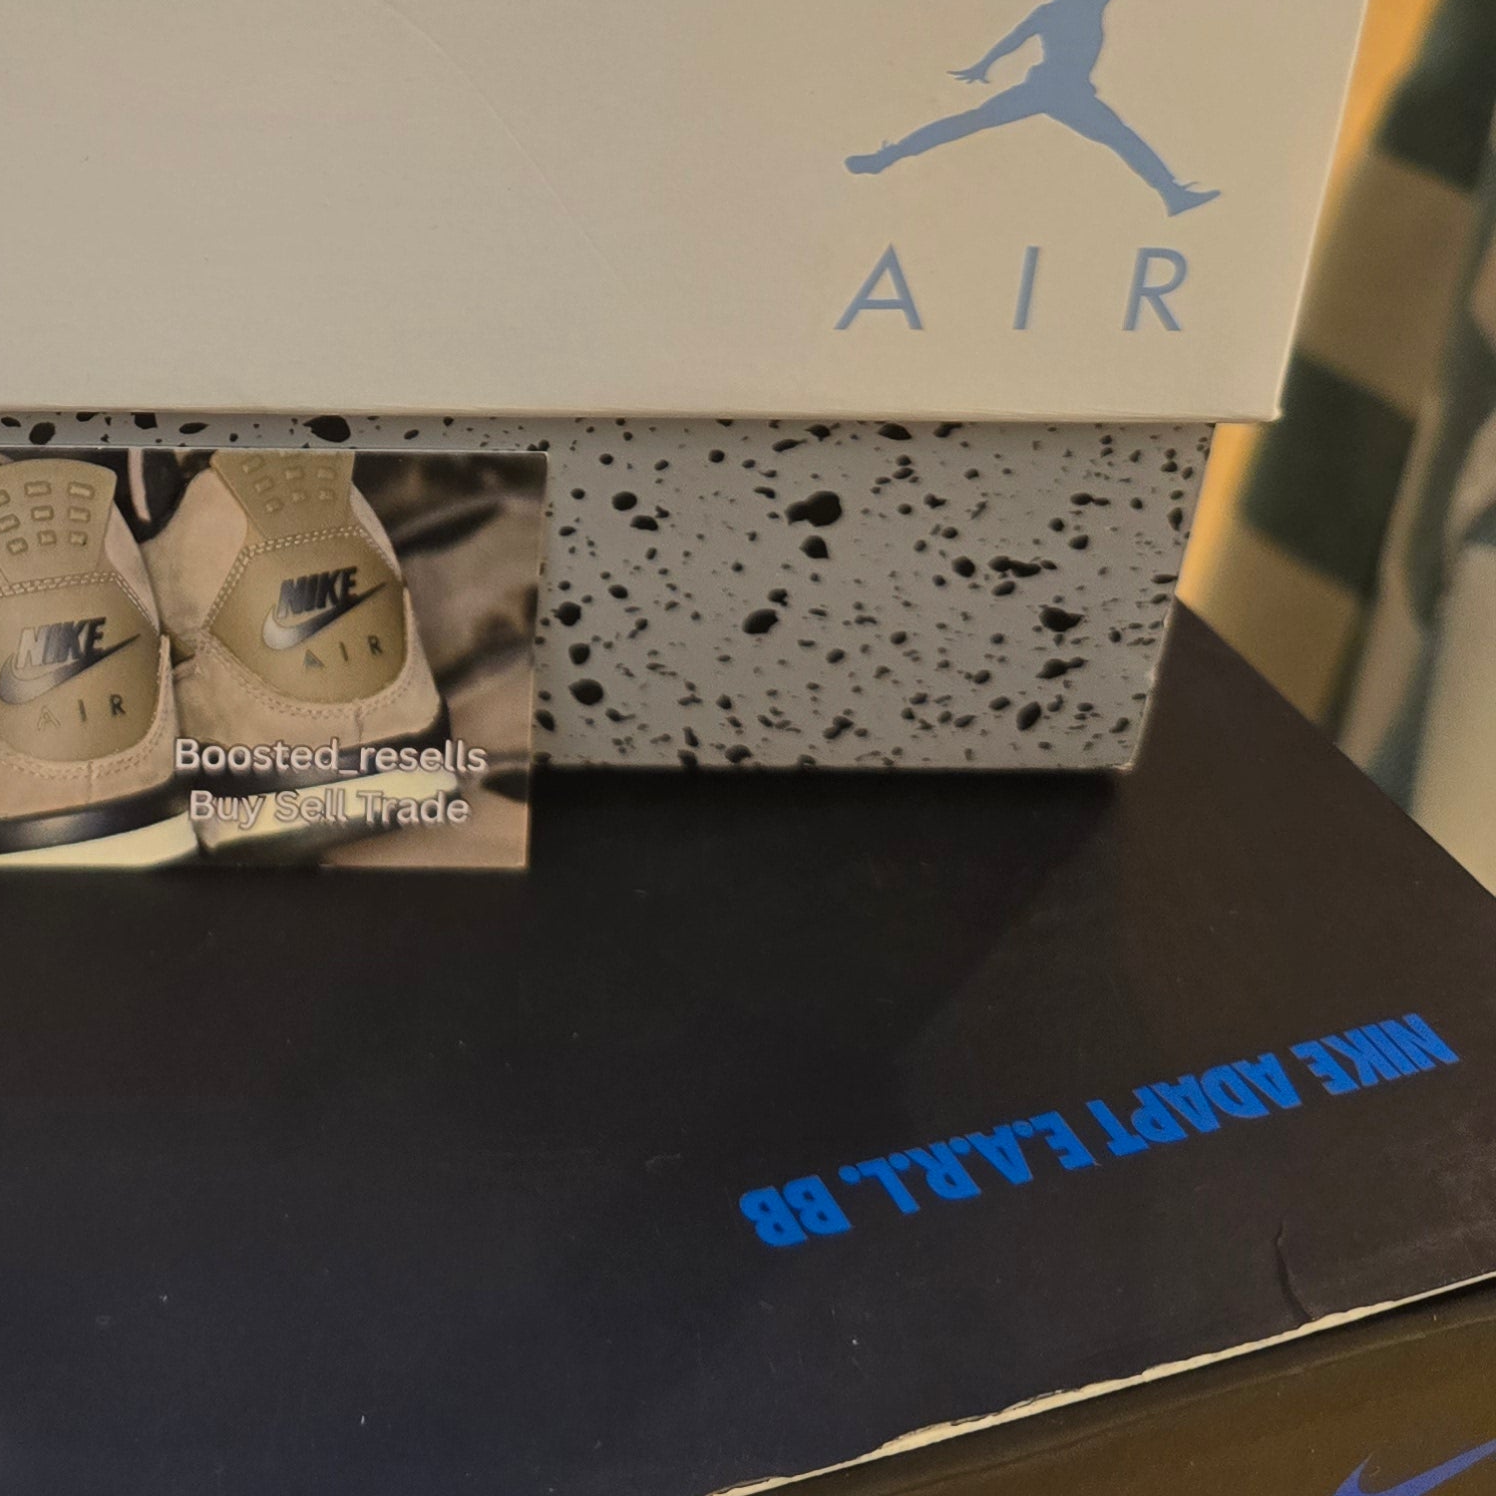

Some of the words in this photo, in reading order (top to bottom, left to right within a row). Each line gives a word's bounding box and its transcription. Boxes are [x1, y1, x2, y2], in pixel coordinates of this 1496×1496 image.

[832, 242, 1189, 332] AIR
[275, 565, 358, 622] NIKE
[15, 616, 107, 671] NIKE
[36, 693, 127, 732] AIR
[174, 737, 489, 775] Boosted_resells
[189, 789, 266, 830] Buy
[274, 787, 349, 823] Sell
[357, 789, 471, 824] Trade
[1288, 1012, 1461, 1096] NIKE
[1085, 1050, 1303, 1157] ADAPT
[837, 1110, 1101, 1215] E.A.R.L.
[738, 1174, 854, 1248] BB
